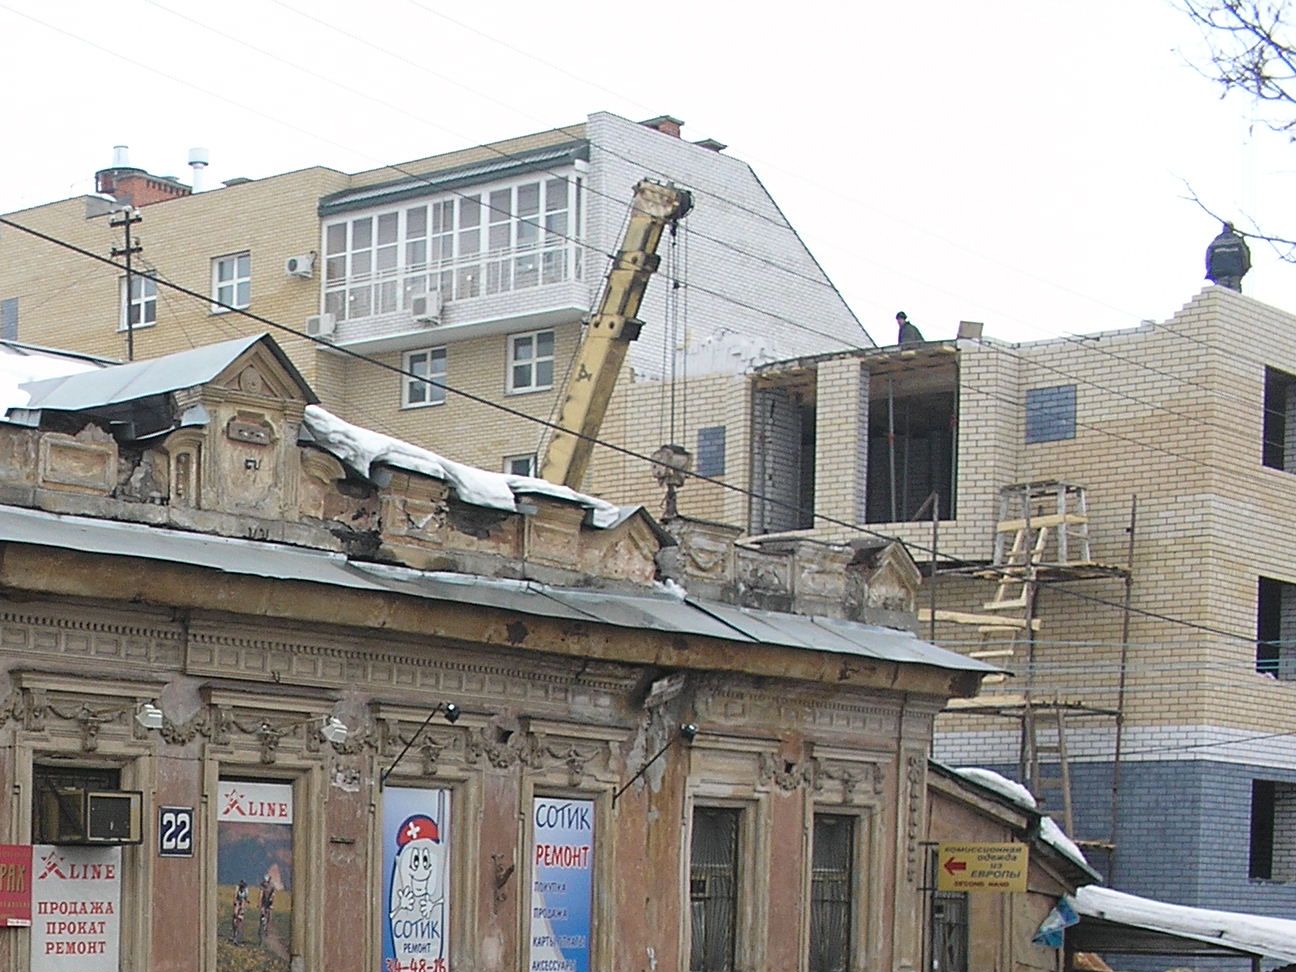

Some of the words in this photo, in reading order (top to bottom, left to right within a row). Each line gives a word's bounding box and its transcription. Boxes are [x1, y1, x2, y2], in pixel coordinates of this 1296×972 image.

[536, 803, 591, 830] СОТИК
[162, 812, 190, 850] 22
[536, 844, 590, 867] РЕМОНТ
[977, 854, 1017, 862] одежда
[970, 870, 1021, 879] ЕВРОПЫ
[534, 881, 567, 893] ПОКУПКА
[37, 902, 114, 916] ПРОДАЖА
[533, 907, 568, 919] ПРОДАЖА
[46, 922, 106, 935] ПРОКАТ
[394, 918, 440, 939] СОТИК
[45, 942, 106, 955] РЕМОНТ
[403, 942, 432, 954] РЕМОНТ
